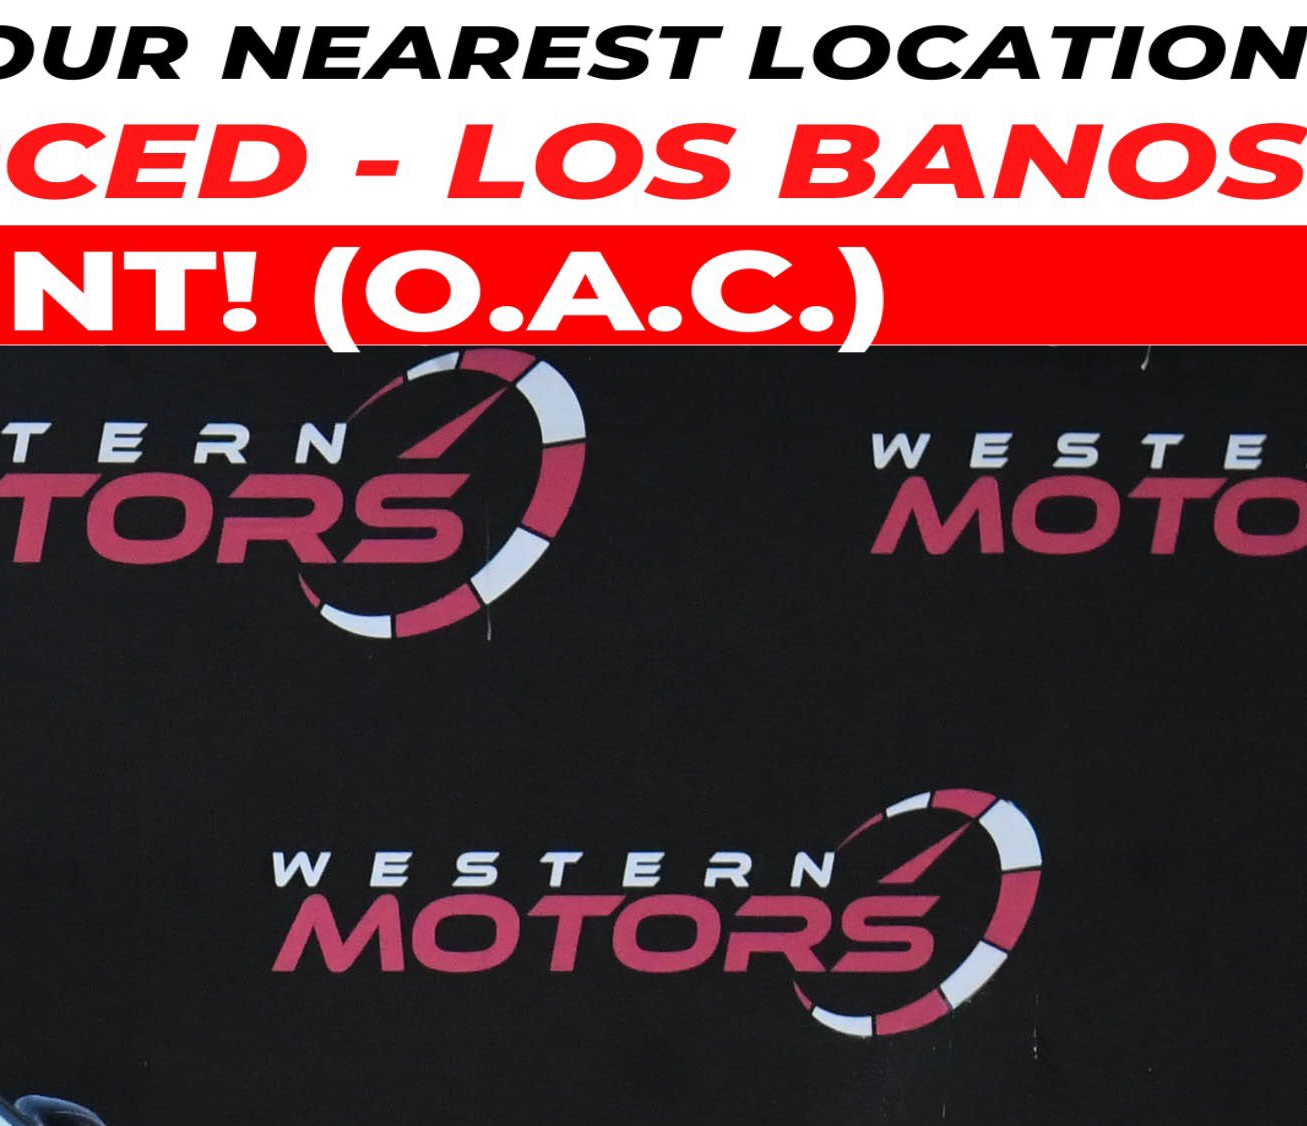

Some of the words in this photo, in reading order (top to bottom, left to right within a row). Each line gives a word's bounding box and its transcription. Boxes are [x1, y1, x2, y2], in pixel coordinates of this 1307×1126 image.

[873, 434, 1266, 469] WESTE
[872, 476, 1307, 555] MOTO
[273, 852, 834, 887] WESTERN
[273, 895, 937, 972] MOTORS
